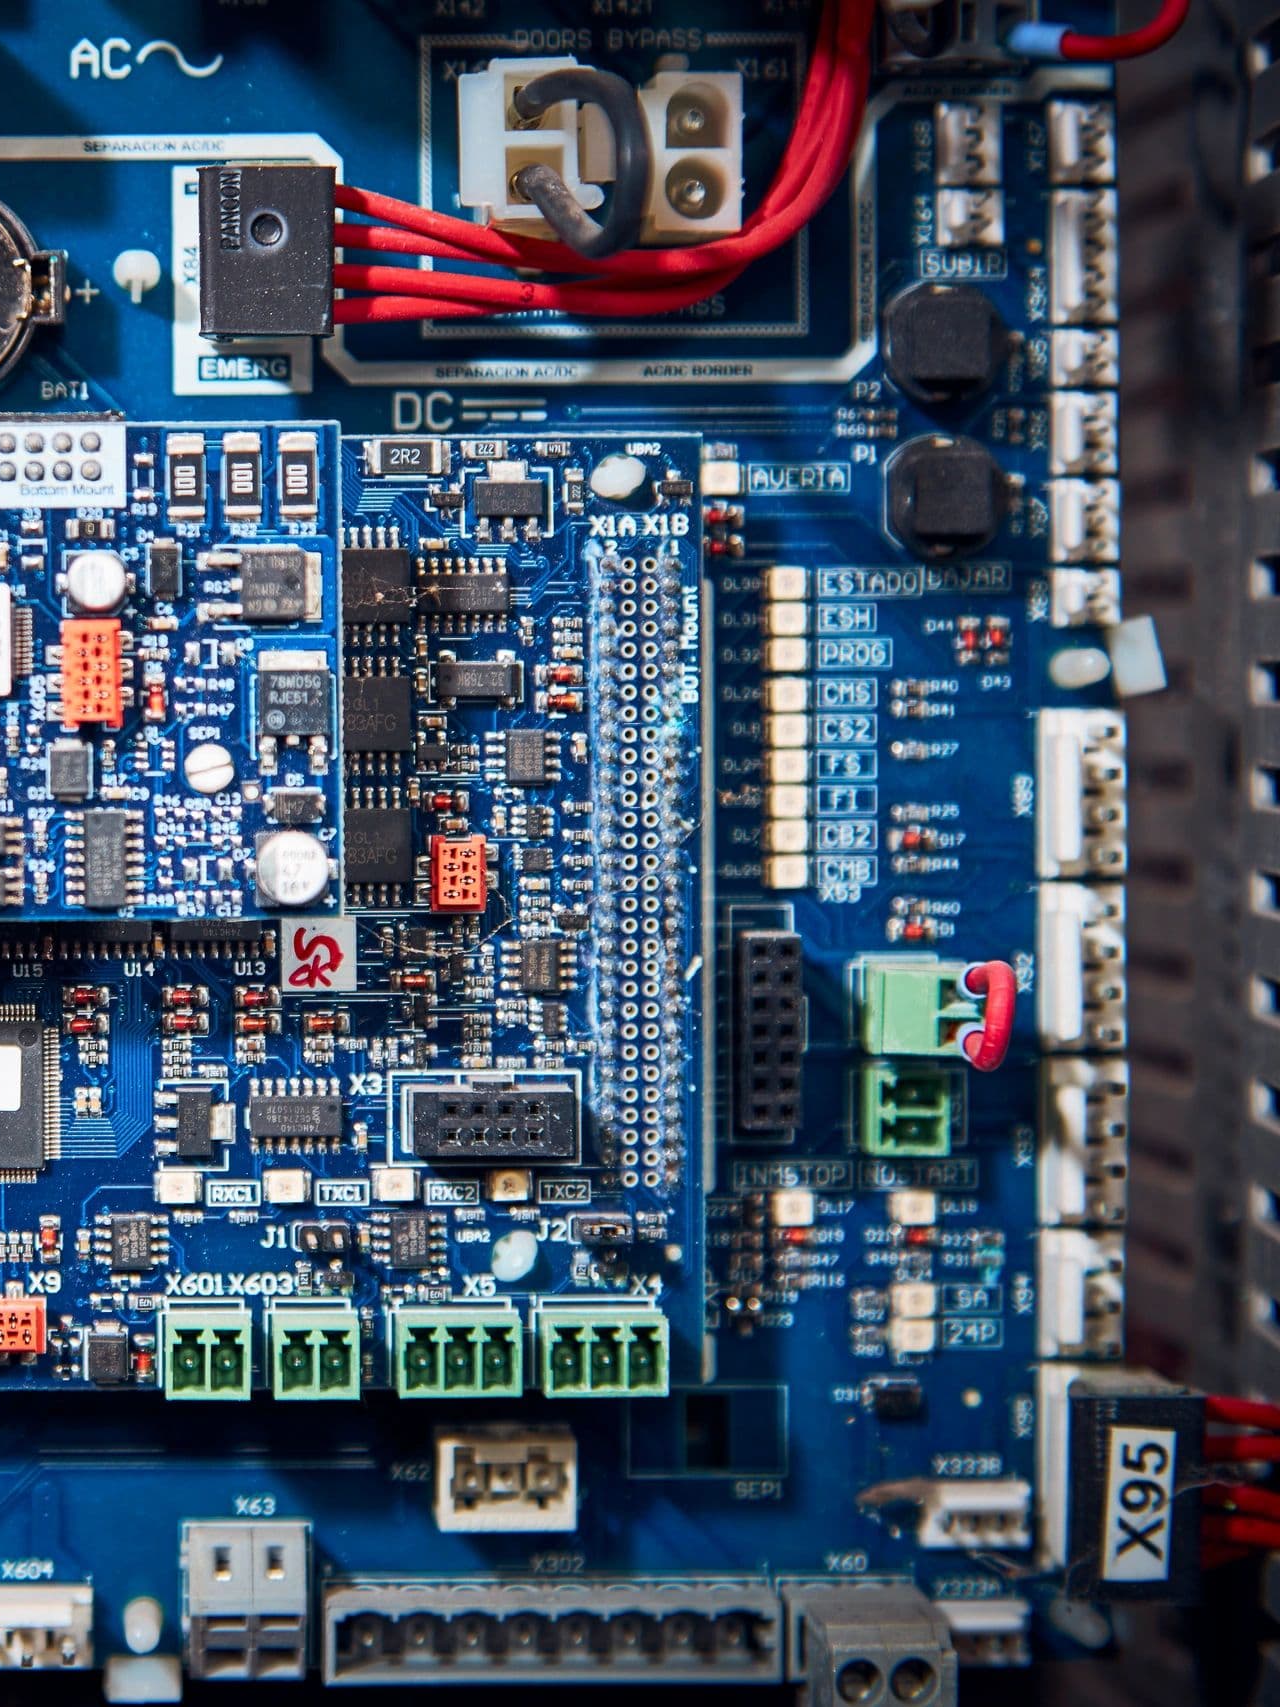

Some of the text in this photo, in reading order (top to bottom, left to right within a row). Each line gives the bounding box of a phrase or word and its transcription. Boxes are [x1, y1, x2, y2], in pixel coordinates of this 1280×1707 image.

[513, 28, 703, 50] DOORS BYPASS
[70, 38, 132, 79] AC
[219, 168, 241, 251] PANCON
[201, 358, 288, 380] EMERG
[691, 363, 754, 376] BORDER
[41, 380, 89, 400] BAT1
[855, 381, 882, 399] P2
[394, 392, 454, 431] DC
[390, 448, 421, 464] 2R2
[853, 444, 876, 464] P1
[752, 469, 846, 489] AVERIA
[590, 516, 638, 537] X1A
[643, 515, 689, 536] X1B
[822, 574, 917, 596] ESTADO
[822, 607, 870, 630] ESH
[822, 644, 886, 667] PROG
[823, 680, 870, 704] CMS
[823, 717, 870, 740] CS2
[829, 755, 862, 776] FS
[823, 823, 870, 847] CB2
[823, 860, 870, 881] CMB
[821, 881, 862, 903] X53
[11, 963, 44, 978] U15
[123, 962, 156, 977] U14
[233, 961, 267, 976] U13
[348, 1073, 384, 1095] X3
[212, 1186, 252, 1201] RXC1
[321, 1185, 362, 1201] TXC1
[430, 1186, 475, 1200] RXC2
[543, 1184, 587, 1200] TXC2
[260, 1225, 287, 1249] J1
[455, 1229, 491, 1243] UBA2
[536, 1222, 567, 1242] J2
[27, 1271, 63, 1293] X9
[166, 1273, 224, 1296] X601
[228, 1273, 293, 1296] X603
[462, 1275, 497, 1297] X5
[631, 1274, 662, 1297] X4
[956, 1286, 989, 1309] SA
[949, 1324, 996, 1345] 24P
[391, 1464, 430, 1482] X62
[236, 1498, 275, 1516] X63
[1116, 1442, 1168, 1562] X95
[1, 1561, 54, 1579] X604
[825, 1554, 867, 1572] X60
